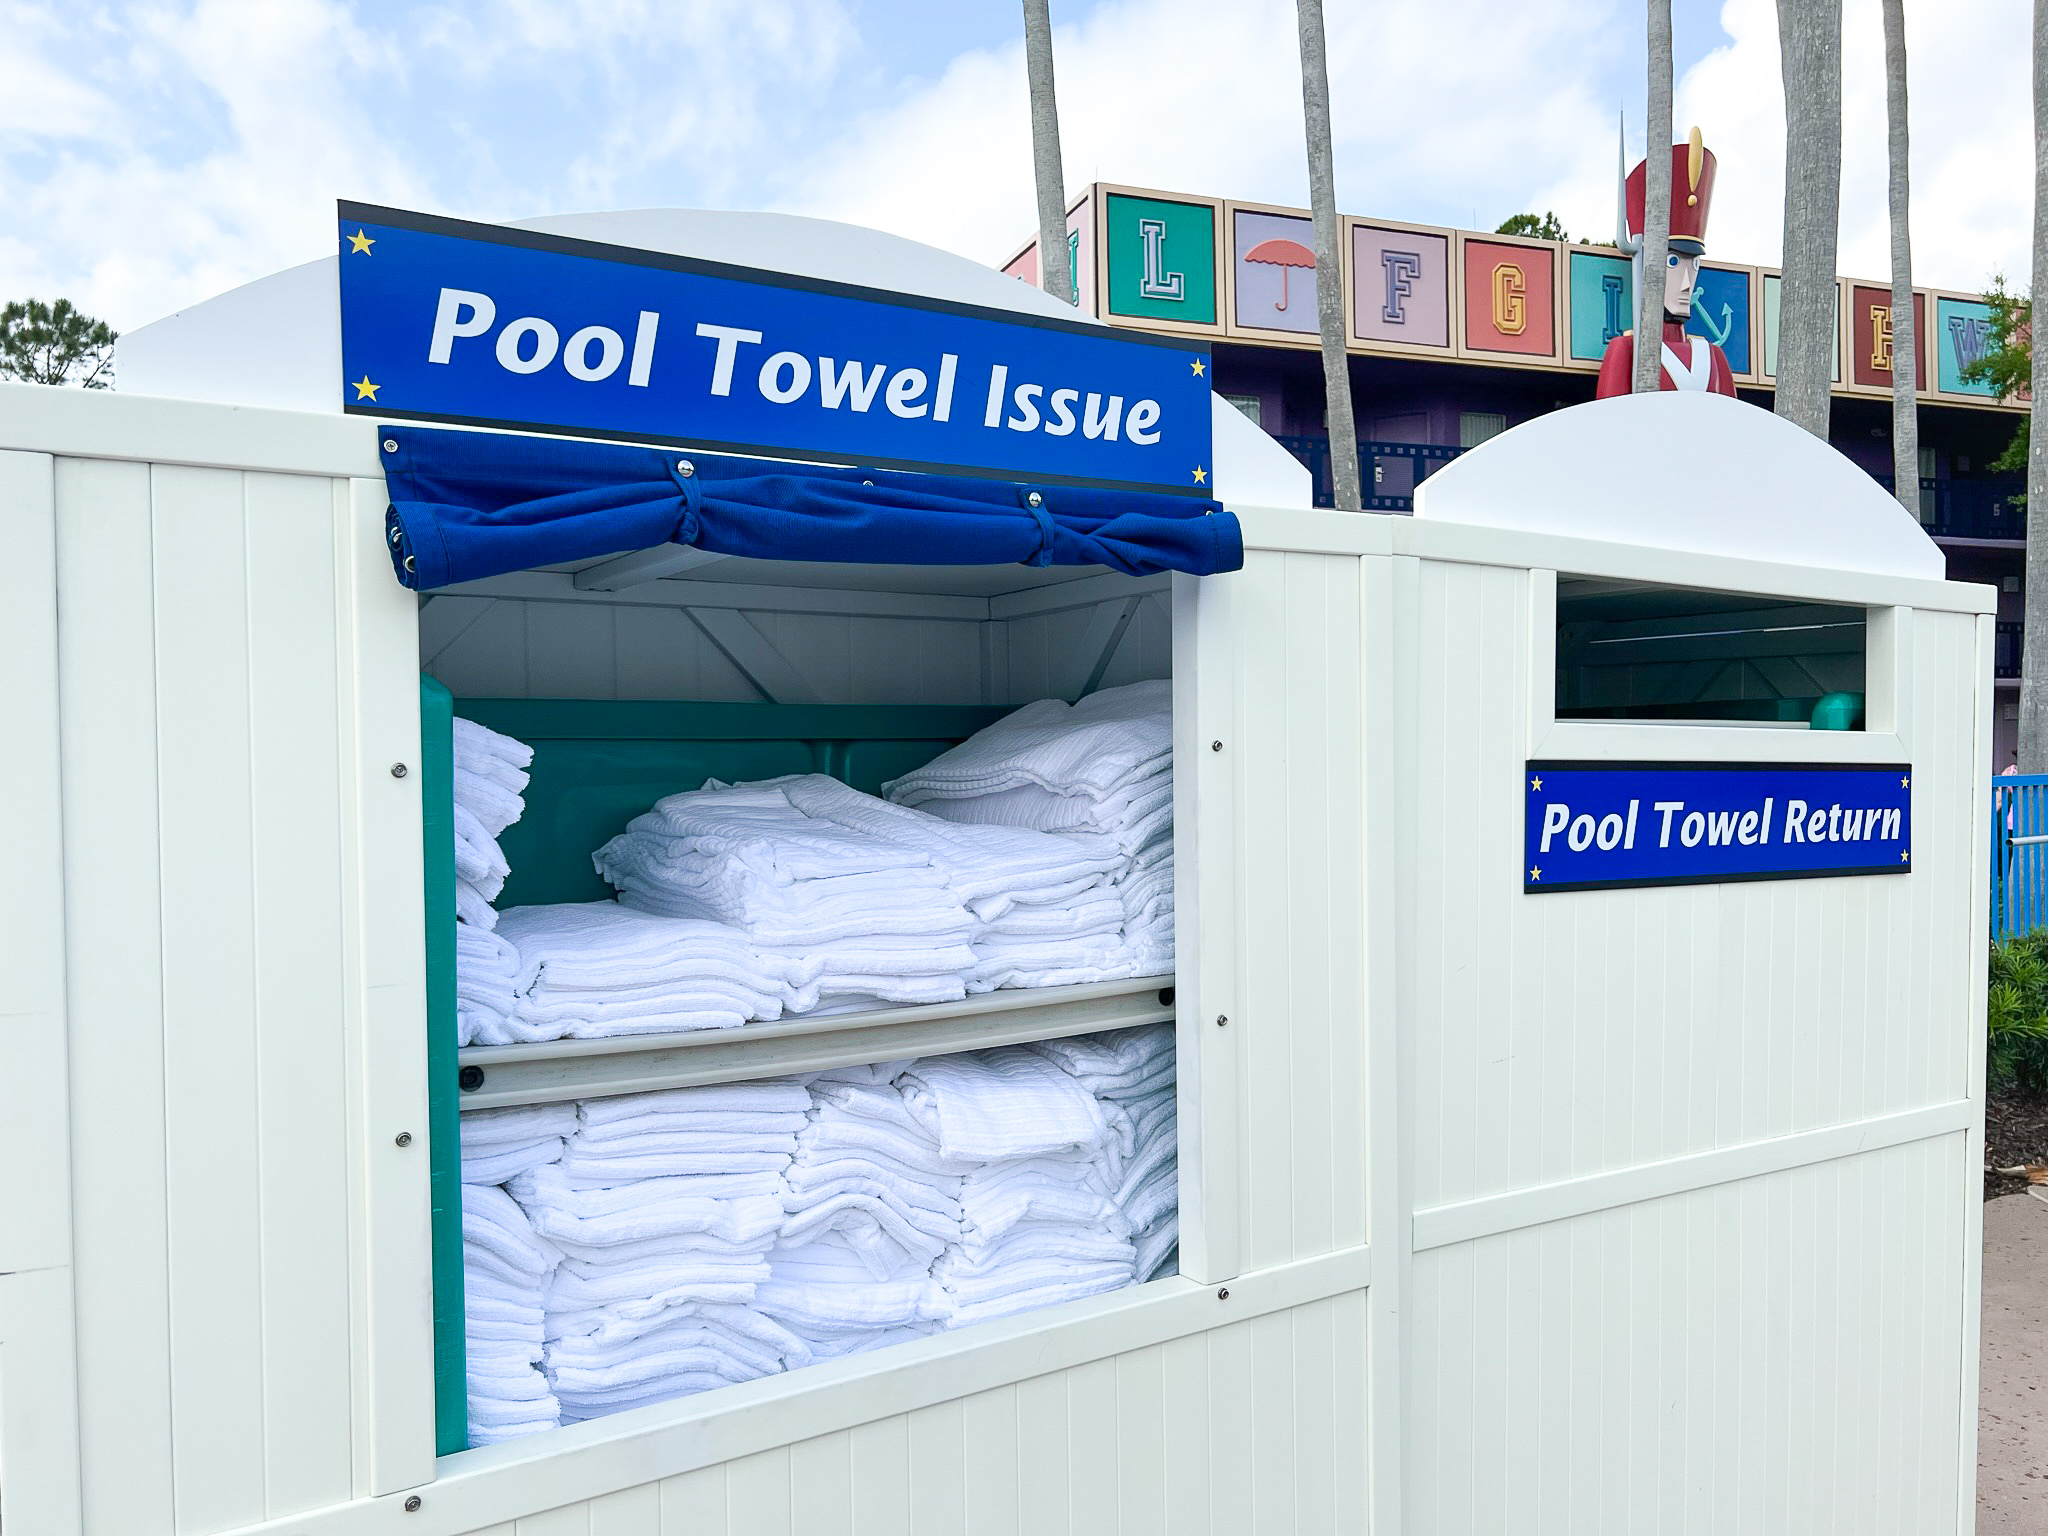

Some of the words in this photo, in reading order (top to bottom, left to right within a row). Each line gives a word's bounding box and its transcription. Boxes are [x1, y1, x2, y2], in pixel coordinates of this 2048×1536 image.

[1139, 218, 1184, 301] L
[1381, 249, 1421, 324] F
[1492, 263, 1526, 334] G
[428, 287, 660, 388] Pool
[695, 322, 959, 423] Towel
[984, 364, 1162, 446] Issue
[1539, 799, 1640, 853] Pool
[1653, 797, 1774, 848] Towel
[1783, 799, 1901, 844] Return
